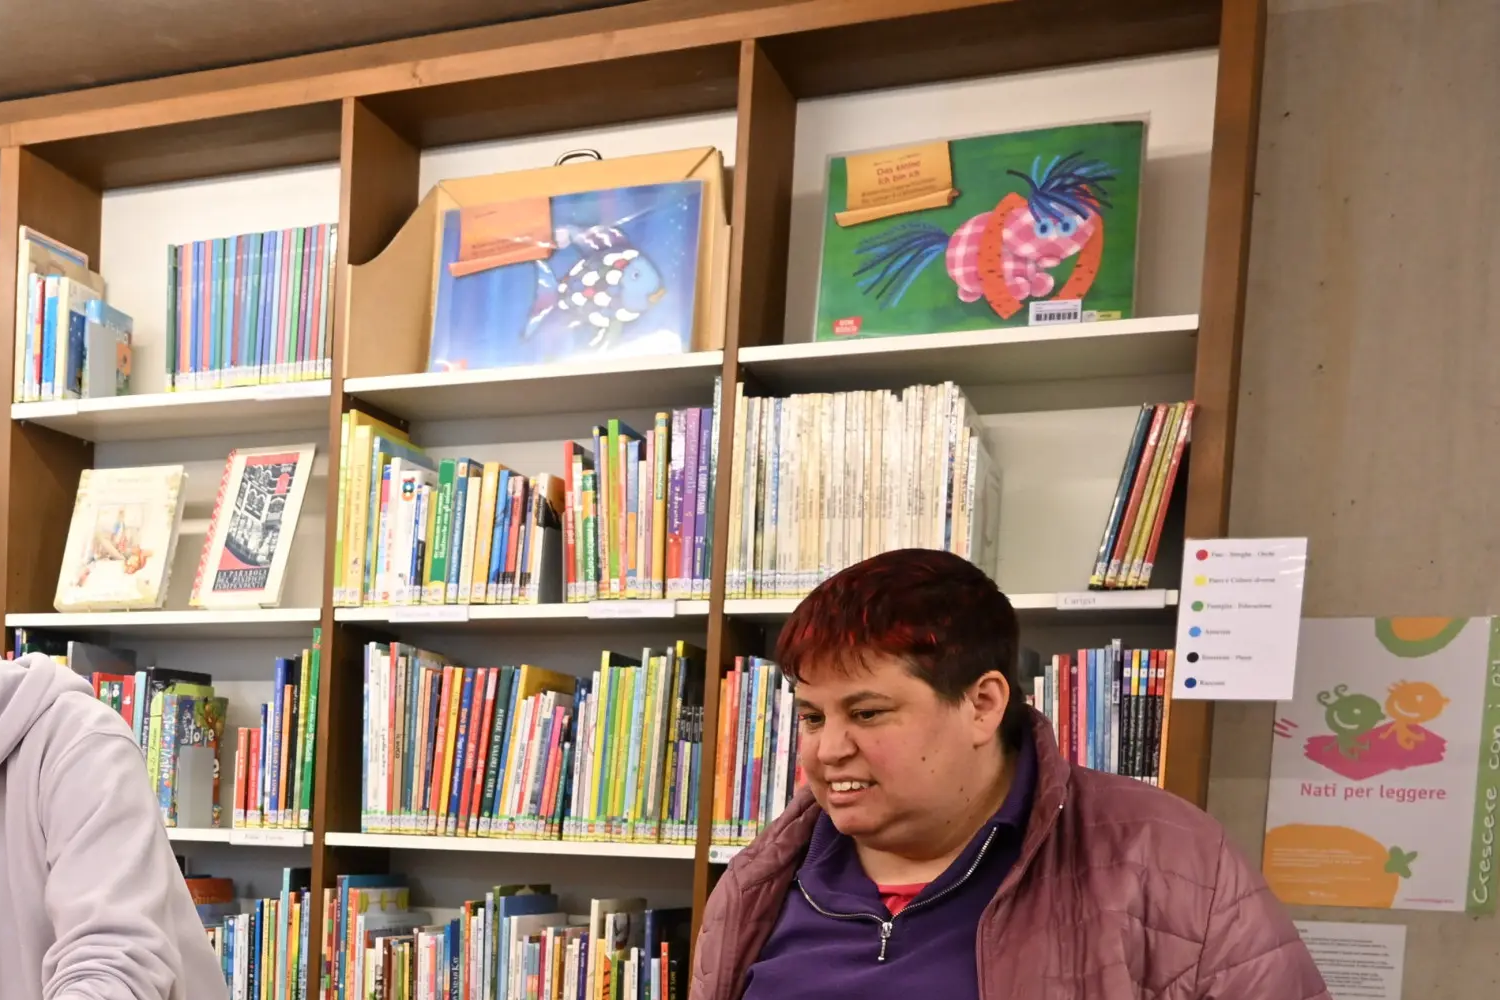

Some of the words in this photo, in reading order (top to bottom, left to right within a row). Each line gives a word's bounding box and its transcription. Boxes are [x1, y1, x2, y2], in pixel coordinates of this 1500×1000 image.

[1299, 782, 1338, 798] Nati
[1343, 784, 1374, 801] per
[1379, 784, 1447, 802] leggere
[1472, 786, 1498, 905] Crescere
